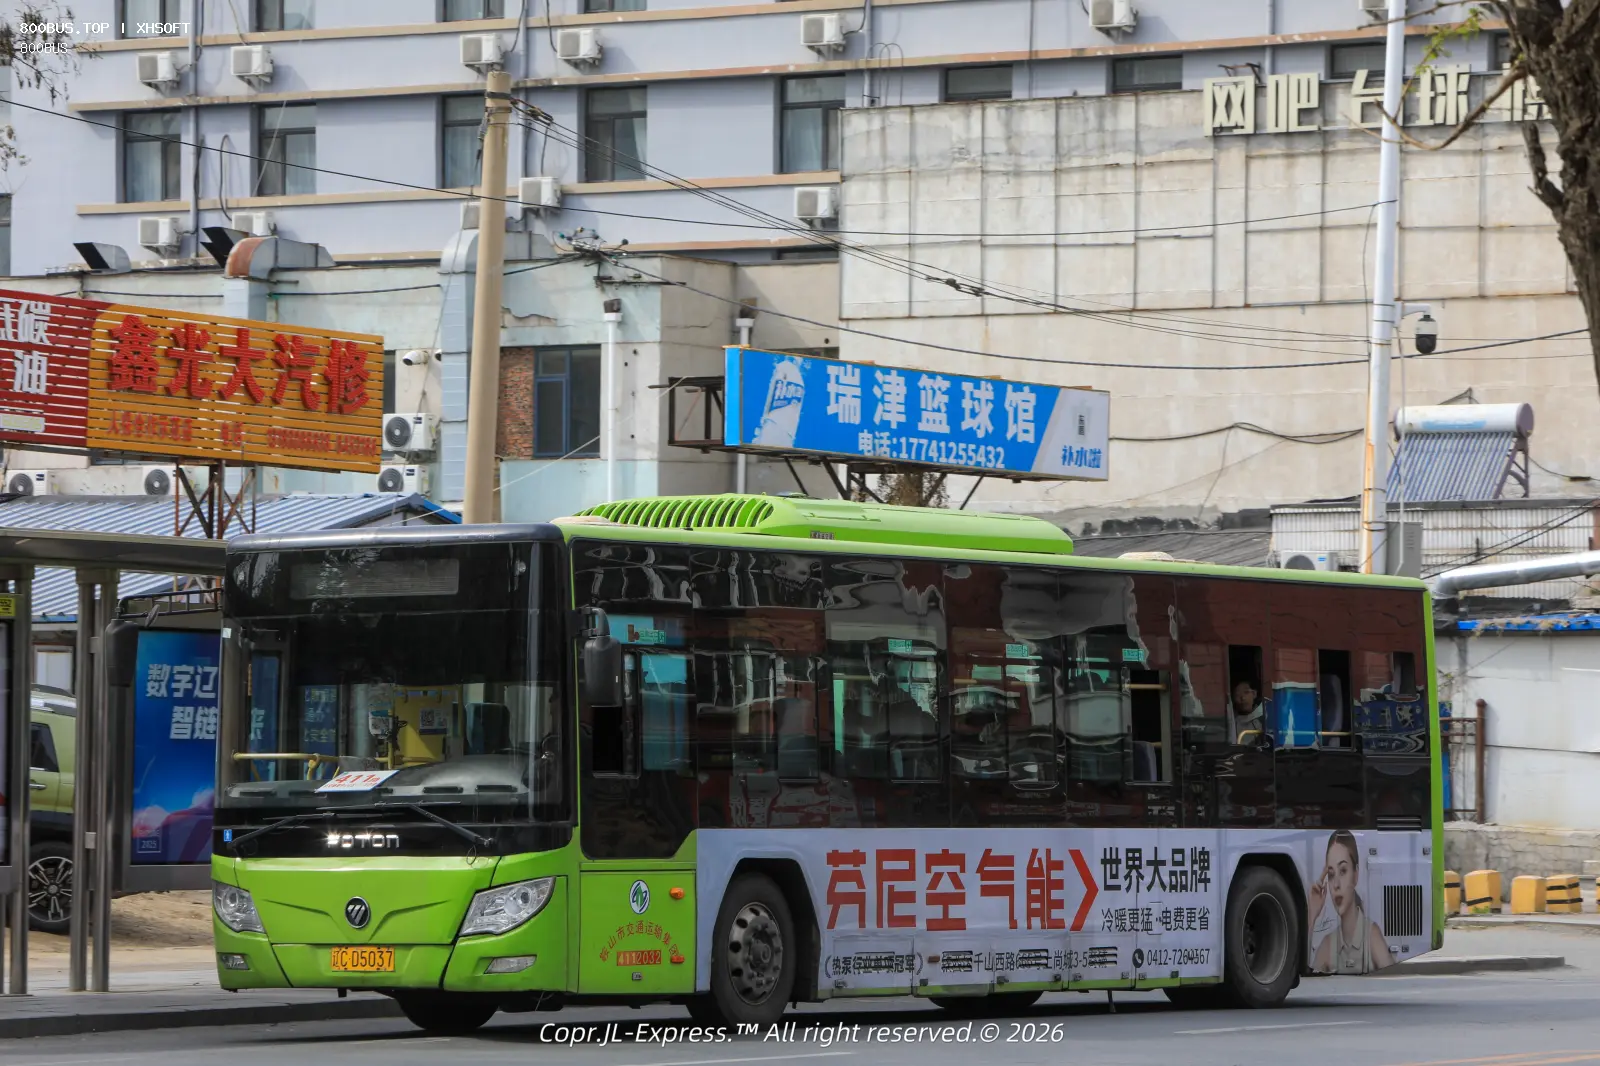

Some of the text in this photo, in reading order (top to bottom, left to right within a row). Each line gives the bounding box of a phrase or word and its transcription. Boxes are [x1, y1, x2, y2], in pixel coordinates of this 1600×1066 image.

[13, 349, 48, 394] 油
[108, 315, 371, 415] 鑫光大汽修
[827, 365, 1036, 443] 瑞津篮球馆
[146, 664, 219, 699] 数字辽
[326, 833, 400, 849] FOTON
[826, 848, 1066, 932] 芬尼空气能
[1100, 846, 1212, 893] 世界大品牌
